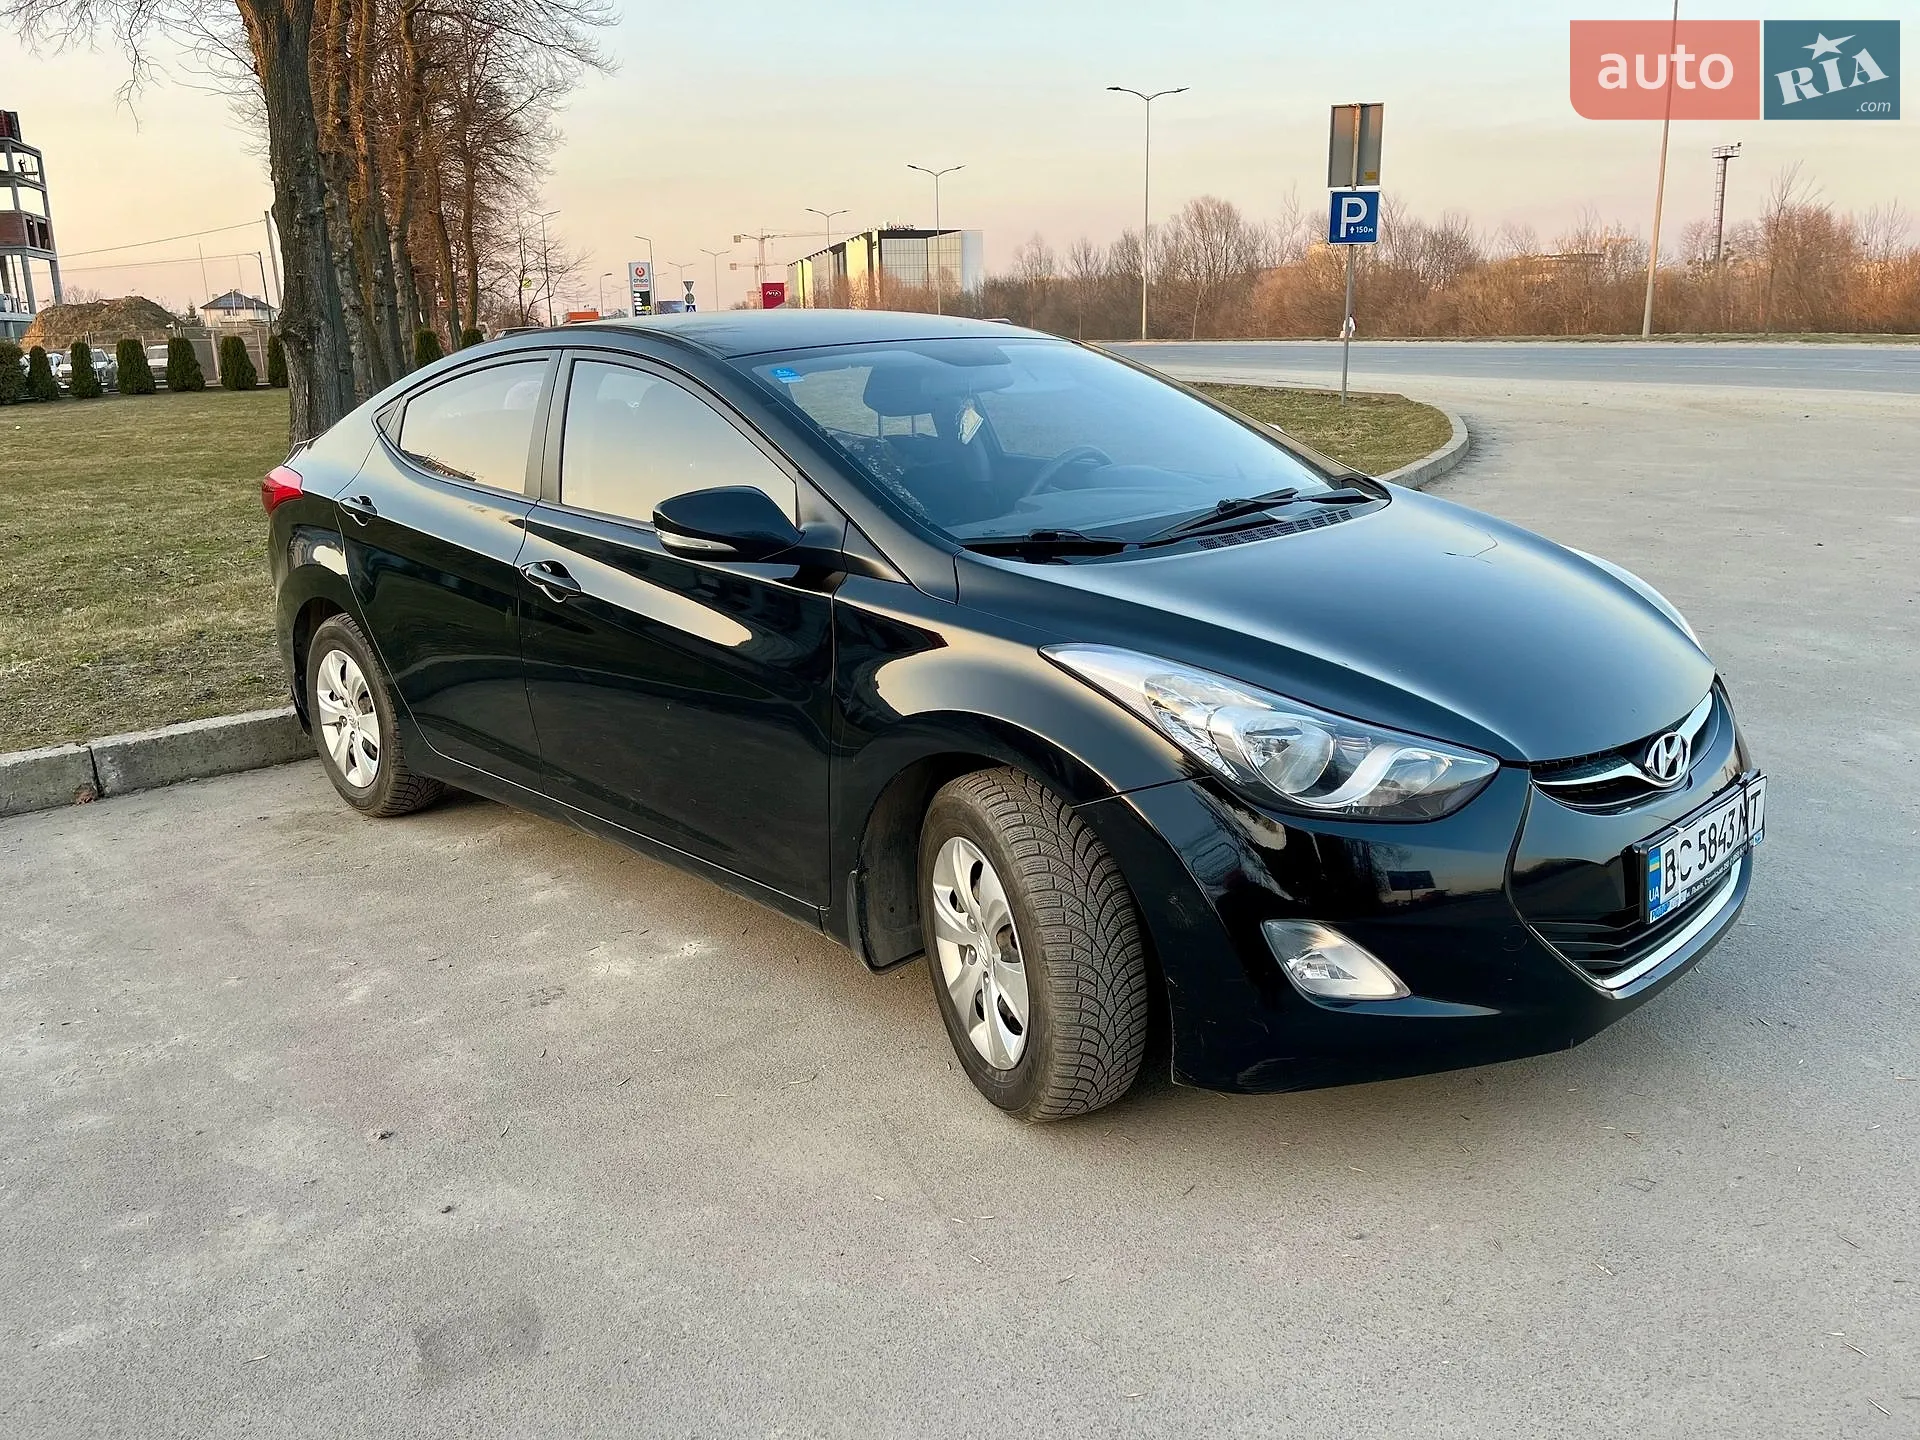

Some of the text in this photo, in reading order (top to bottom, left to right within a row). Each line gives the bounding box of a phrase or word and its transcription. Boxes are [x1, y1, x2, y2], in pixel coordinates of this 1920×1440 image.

[1340, 197, 1368, 238] P
[1664, 840, 1692, 895] BC
[1697, 807, 1736, 870] 5843
[1648, 886, 1660, 902] UA
